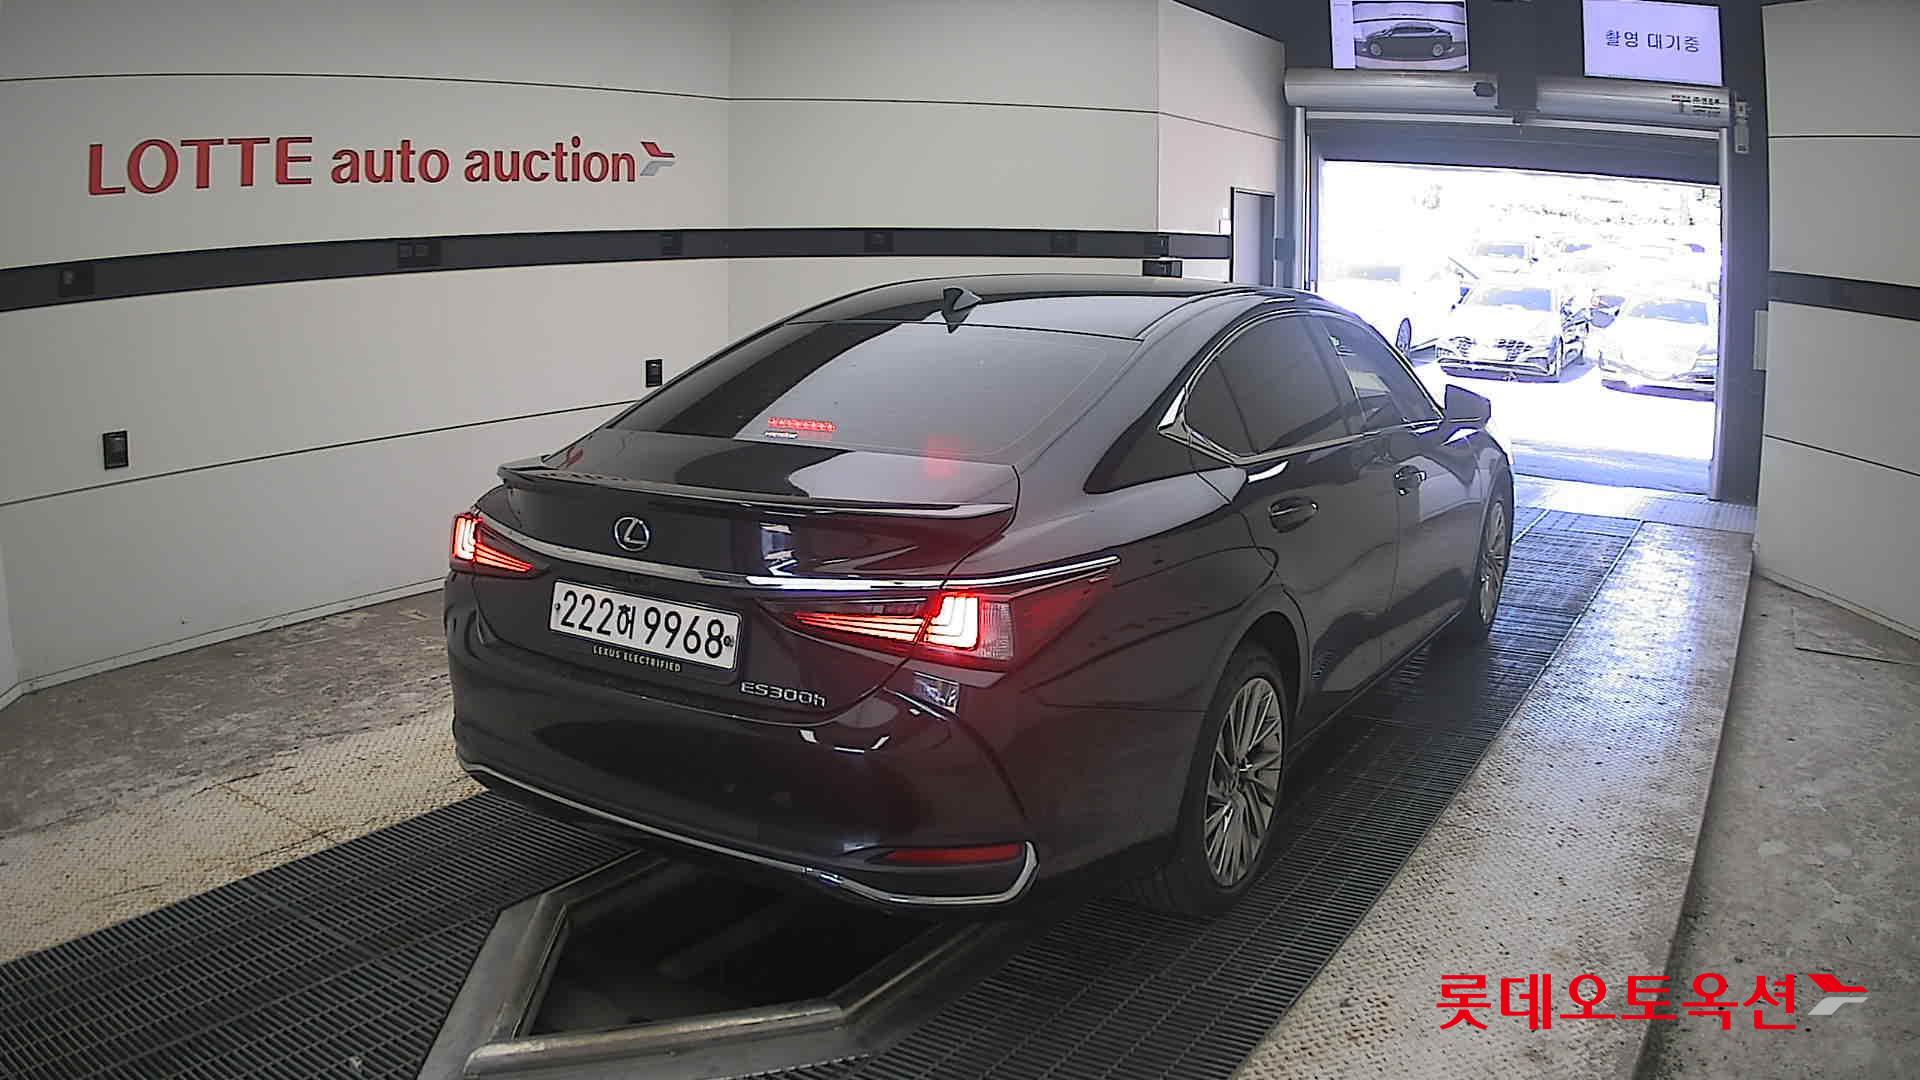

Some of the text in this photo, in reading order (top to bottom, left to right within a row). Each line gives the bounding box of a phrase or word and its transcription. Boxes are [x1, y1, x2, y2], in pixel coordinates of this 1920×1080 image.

[1606, 30, 1699, 53] 촬영 대기중
[89, 136, 636, 195] LOTTE auto auction
[592, 645, 682, 673] LEXUS ELECTRIFIED
[740, 682, 826, 708] ES300h
